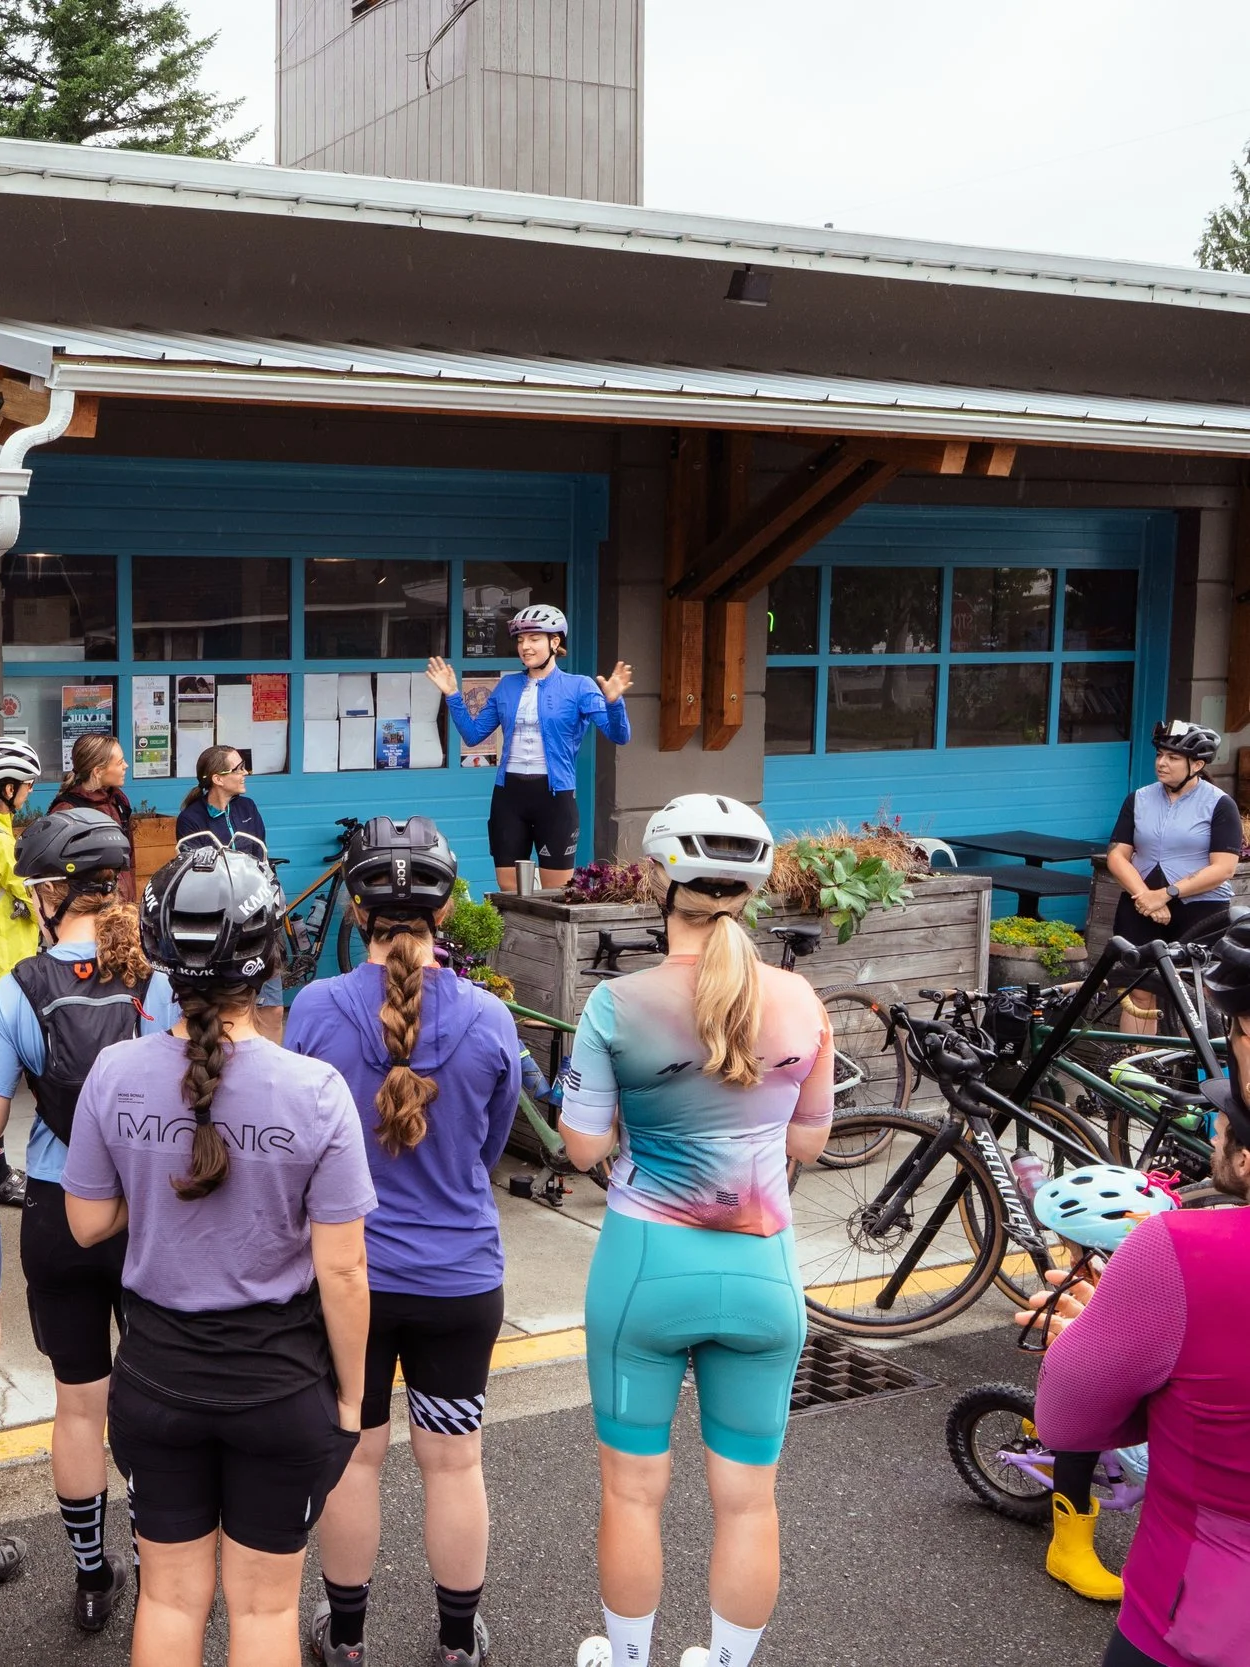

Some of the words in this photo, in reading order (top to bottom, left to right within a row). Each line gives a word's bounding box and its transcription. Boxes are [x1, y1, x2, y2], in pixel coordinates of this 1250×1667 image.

[68, 714, 93, 722] JULY
[96, 713, 107, 721] 18
[179, 967, 215, 977] KASK
[117, 1112, 295, 1155] MONS
